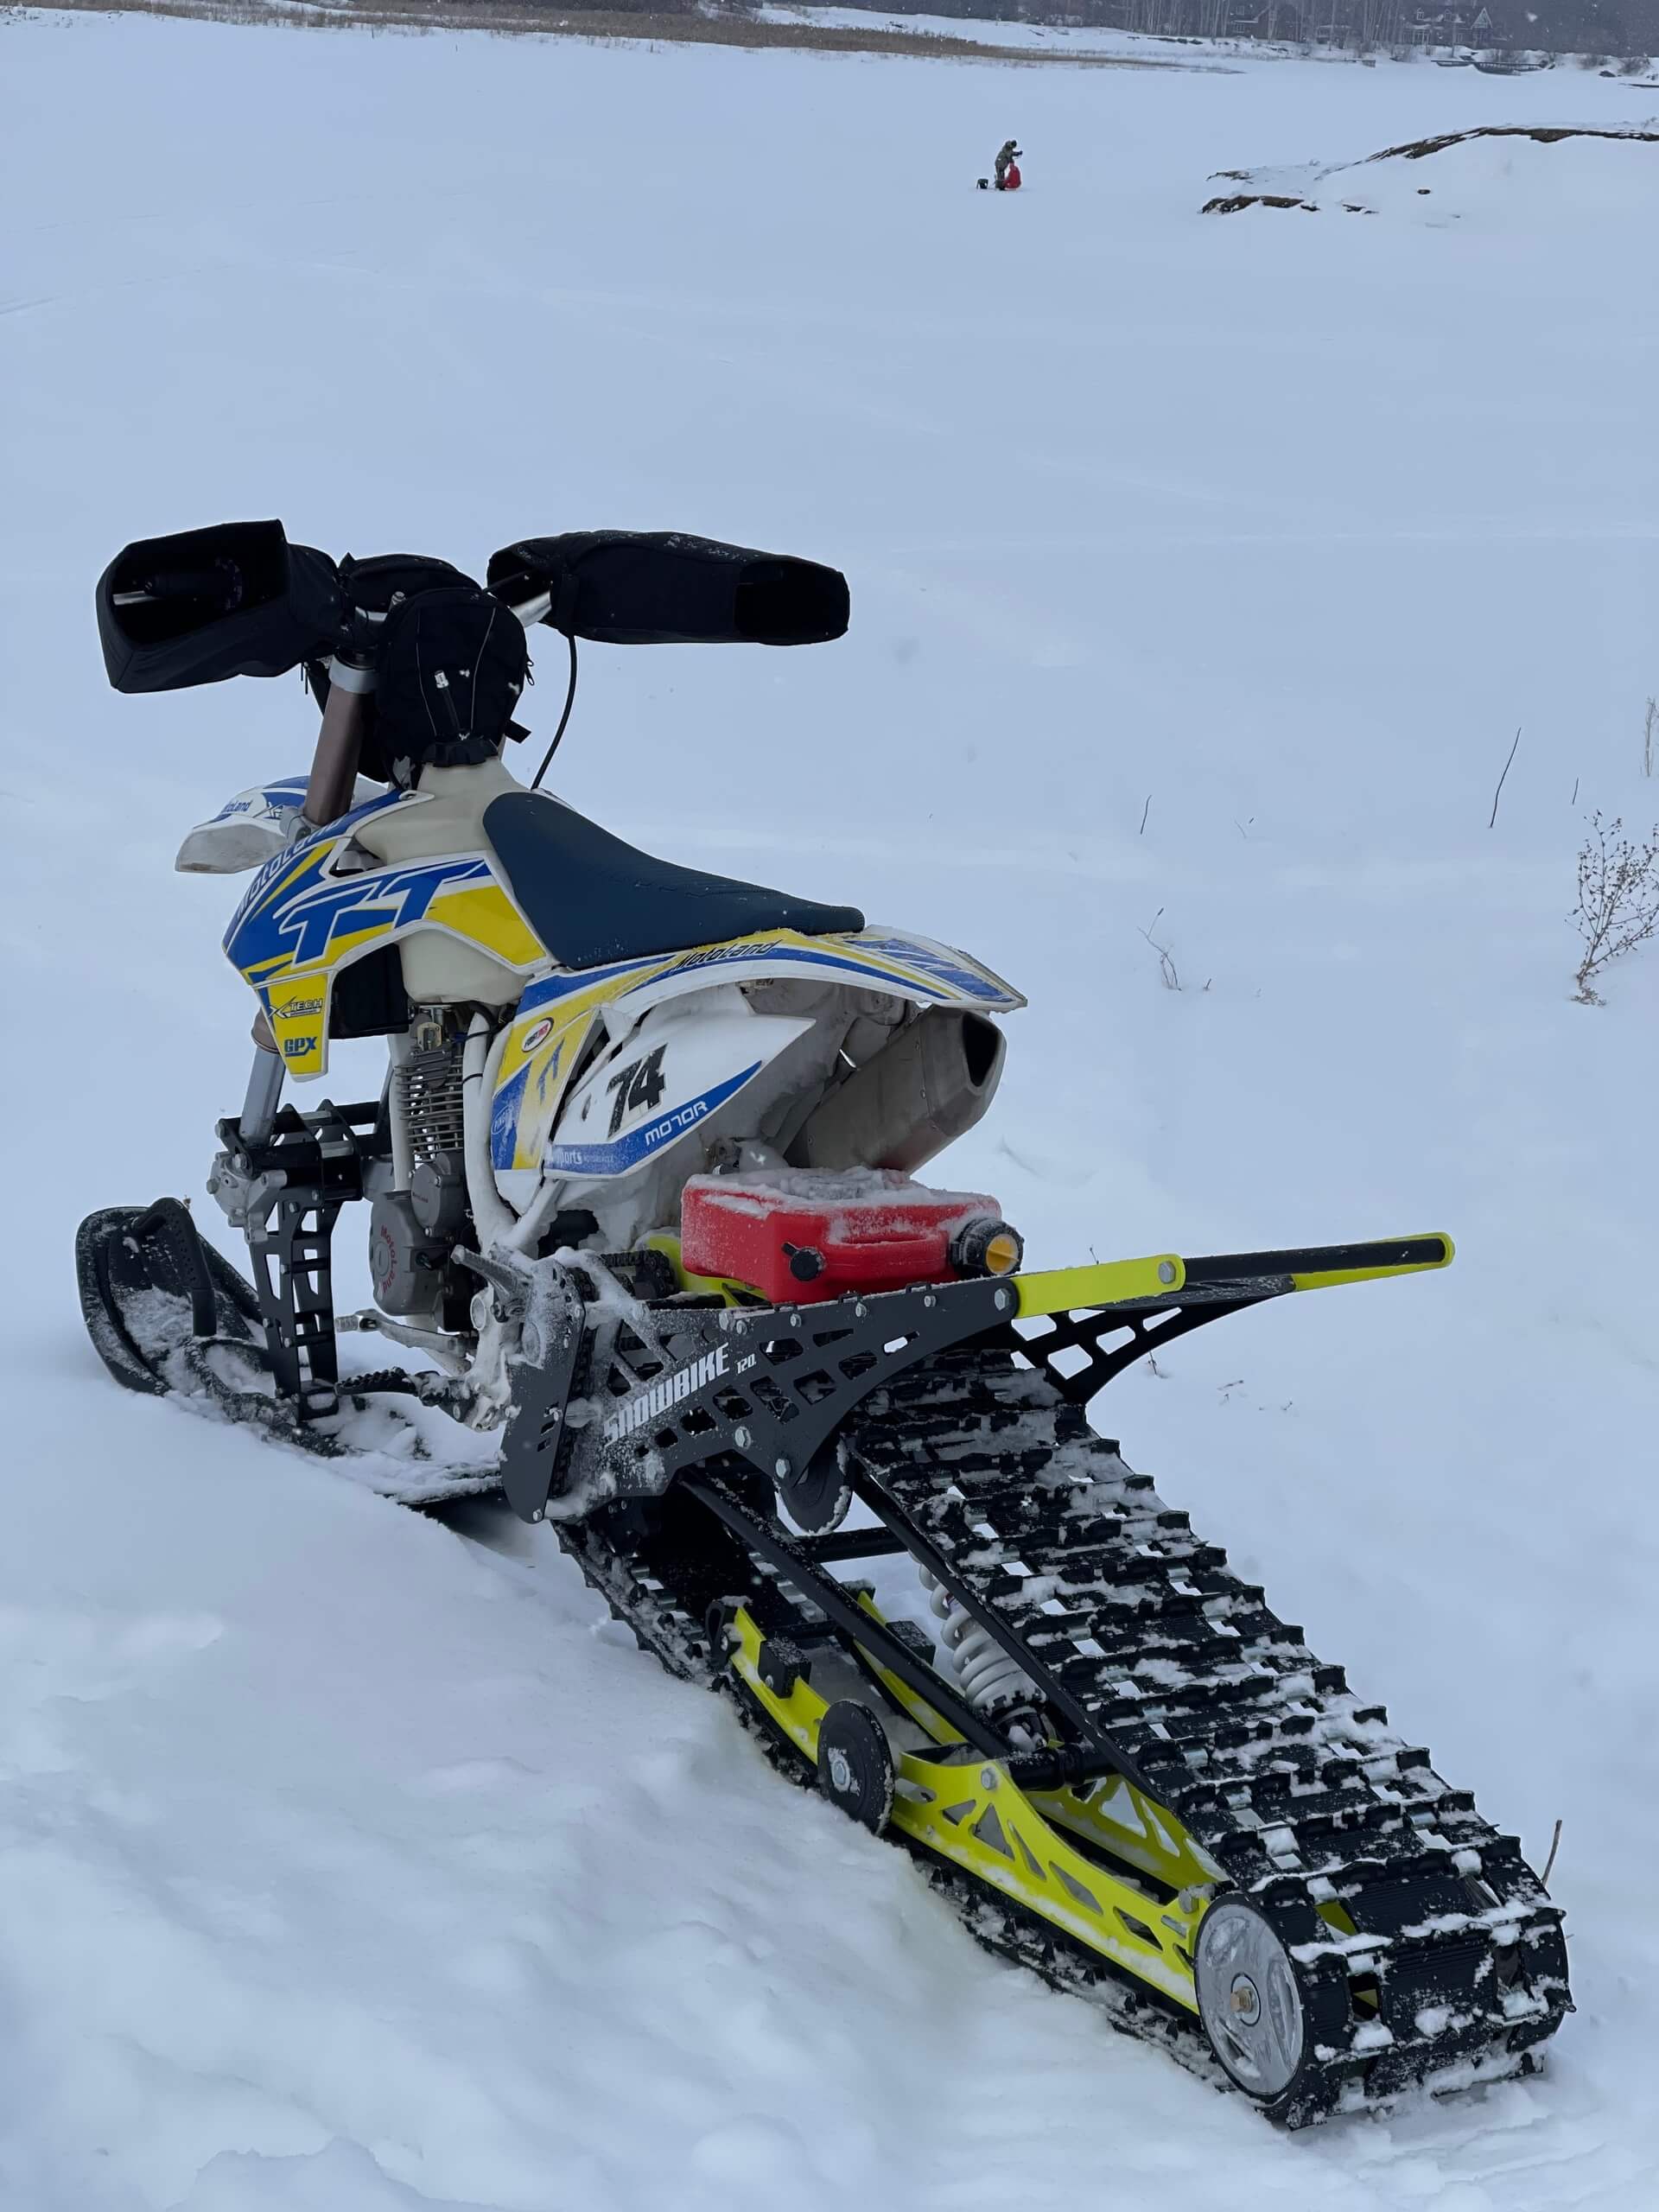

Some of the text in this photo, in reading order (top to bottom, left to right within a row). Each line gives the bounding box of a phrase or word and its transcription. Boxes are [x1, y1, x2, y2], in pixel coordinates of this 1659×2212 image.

[284, 1036, 318, 1057] GPX
[606, 1043, 668, 1140] 74
[645, 1101, 709, 1147] MOTOR
